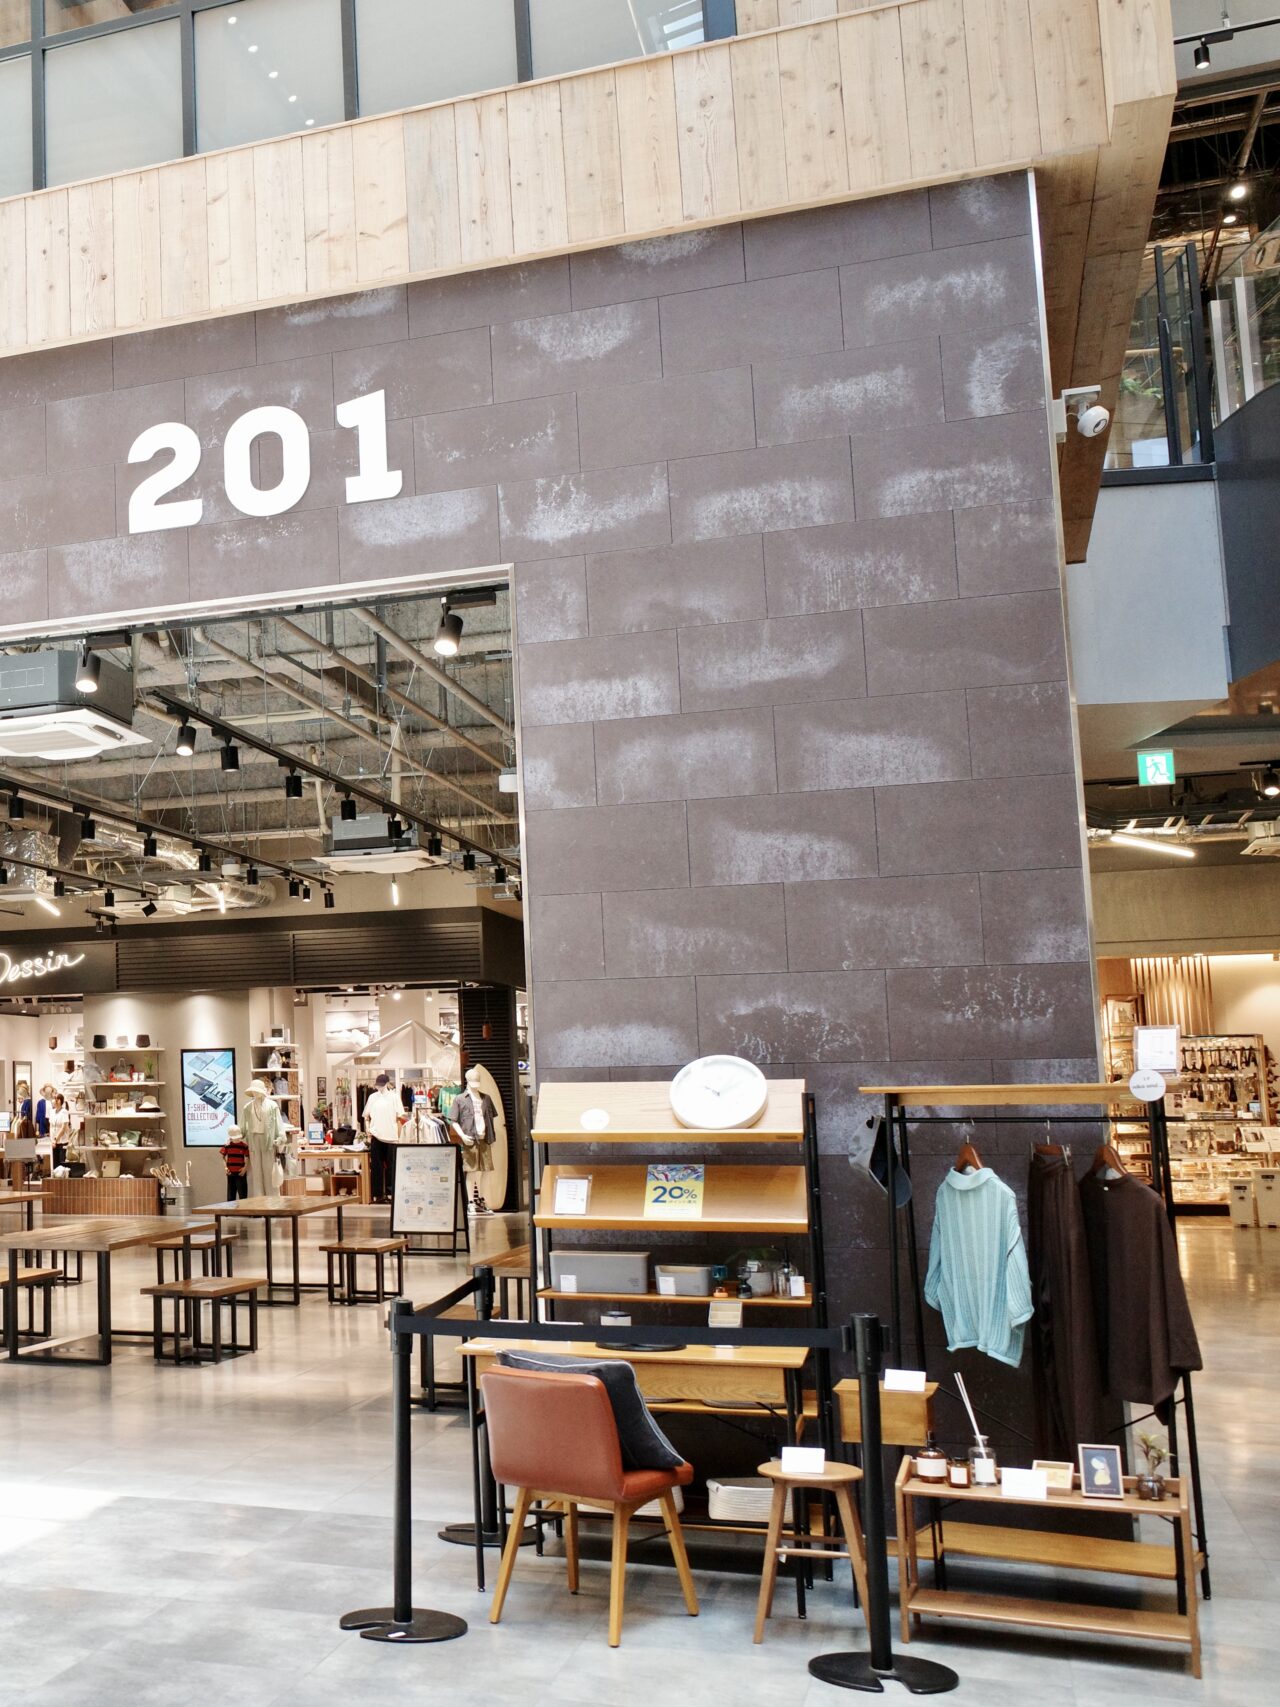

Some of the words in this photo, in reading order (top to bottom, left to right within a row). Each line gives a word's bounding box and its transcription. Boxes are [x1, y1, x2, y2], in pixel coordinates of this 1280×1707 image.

[127, 389, 403, 534] 201
[186, 1103, 209, 1112] T-SHIRT
[187, 1112, 219, 1121] COLLECTION
[652, 1185, 698, 1203] 20%
